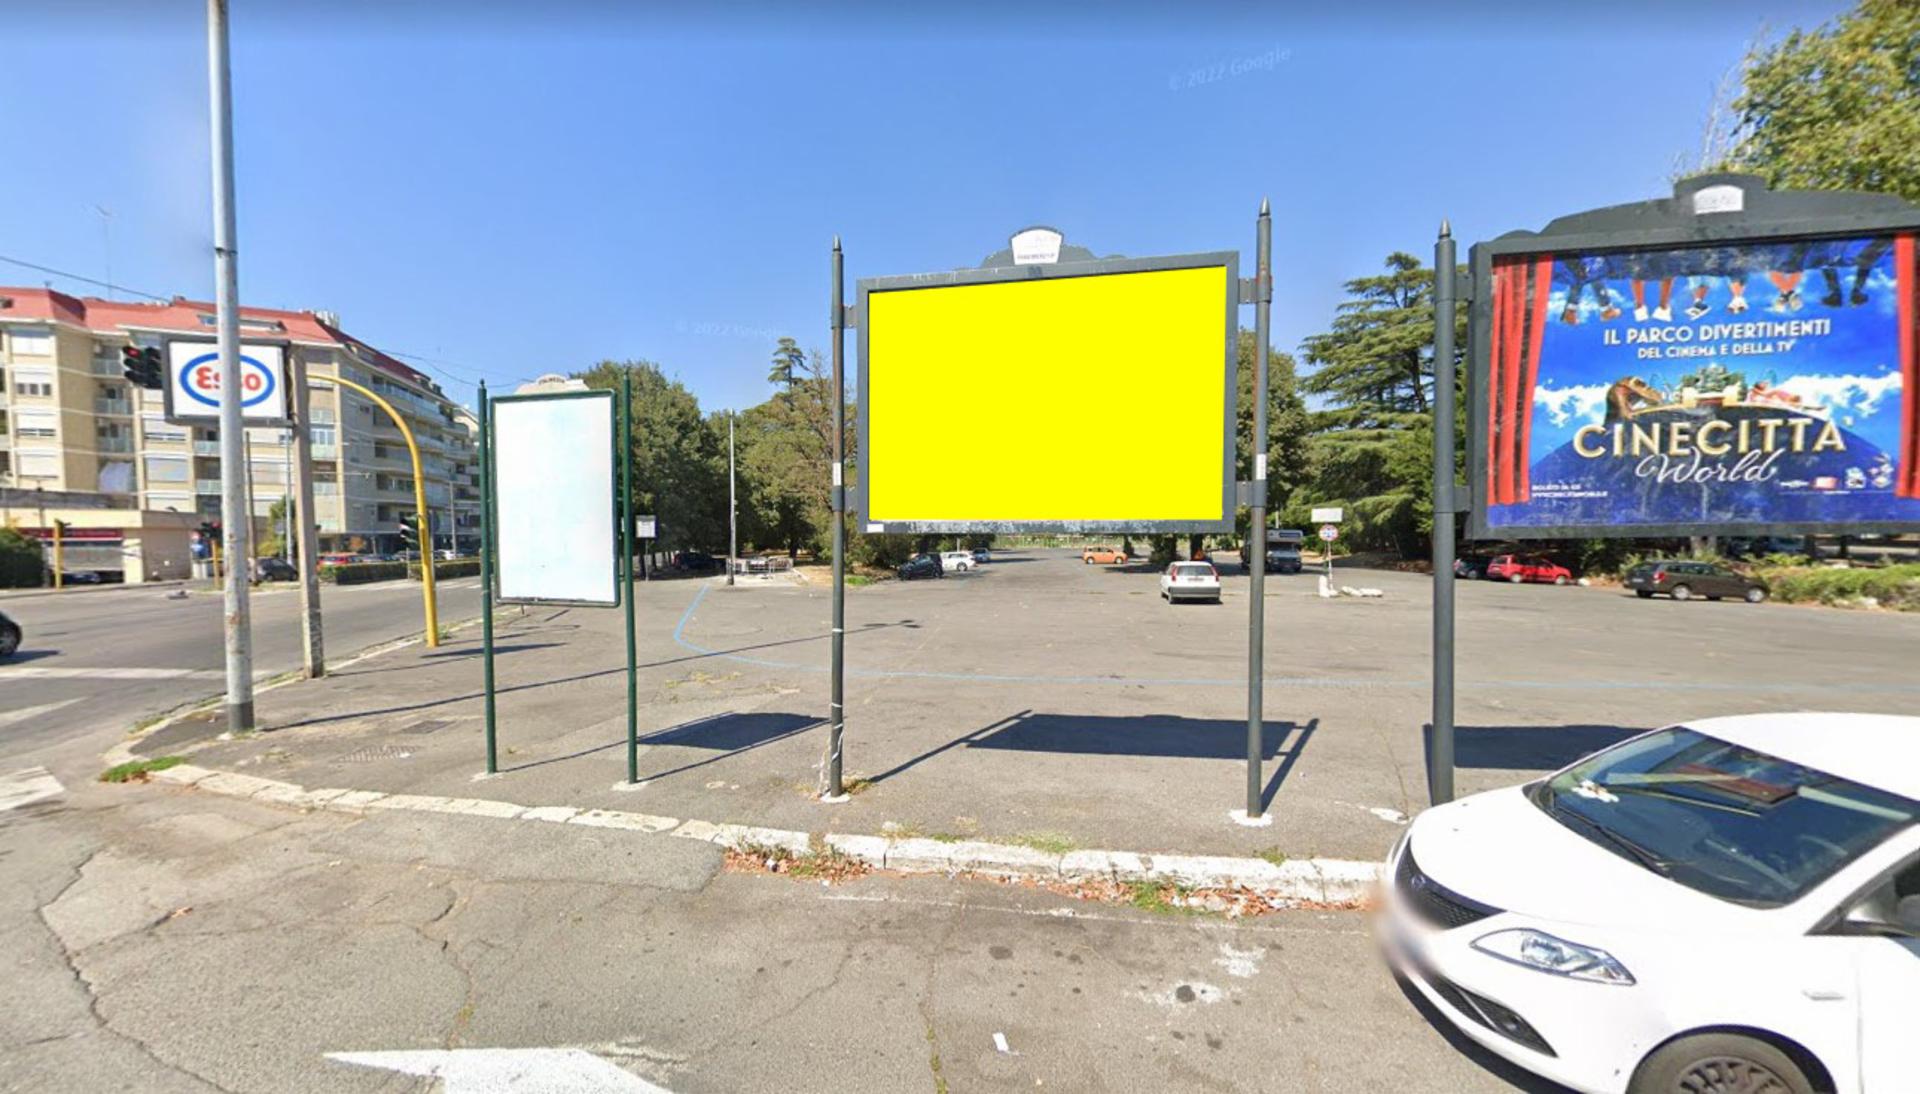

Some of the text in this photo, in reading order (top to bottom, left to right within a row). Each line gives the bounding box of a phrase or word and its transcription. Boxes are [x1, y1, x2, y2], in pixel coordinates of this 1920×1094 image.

[1603, 318, 1831, 345] IL PARCO DIVERTIMENTI
[1637, 339, 1796, 359] DEL CINEMA E DELLA TV
[196, 365, 262, 392] Eo
[1635, 446, 1787, 484] World
